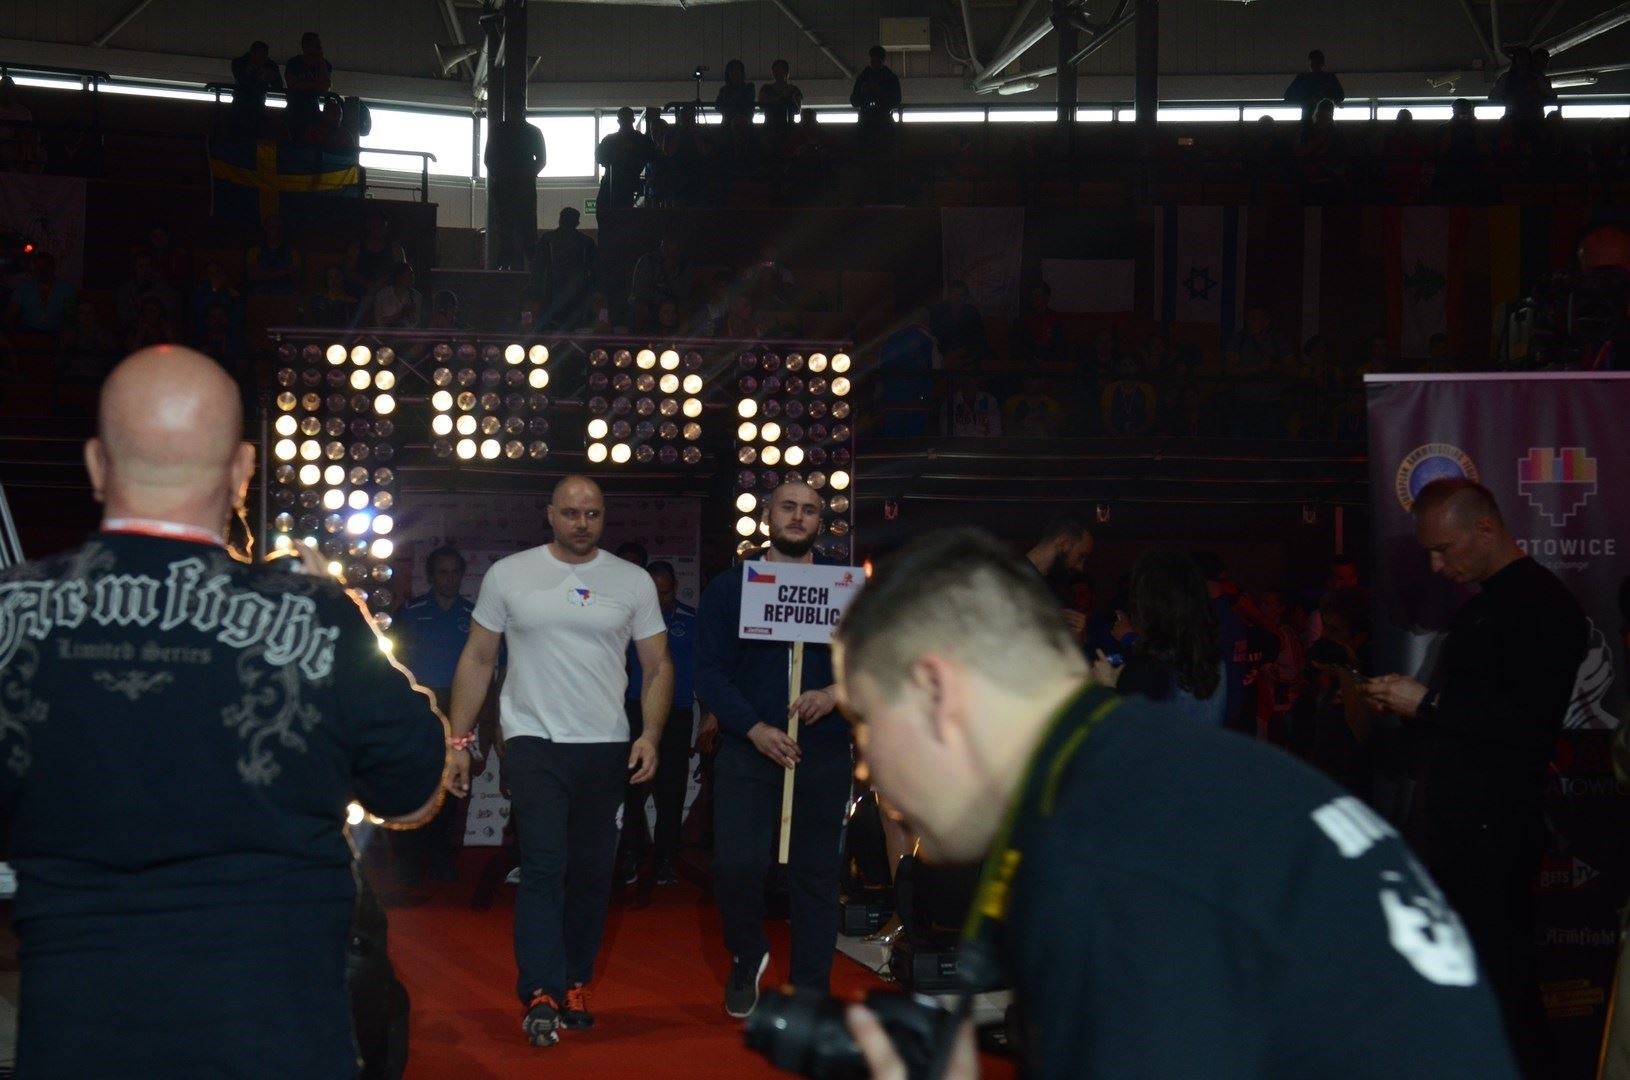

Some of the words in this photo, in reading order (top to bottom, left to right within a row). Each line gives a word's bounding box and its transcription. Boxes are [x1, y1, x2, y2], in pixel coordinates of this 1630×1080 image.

[1516, 538, 1616, 556] ATOWICE
[778, 585, 829, 605] CZECH
[764, 604, 840, 625] REPUBLIC
